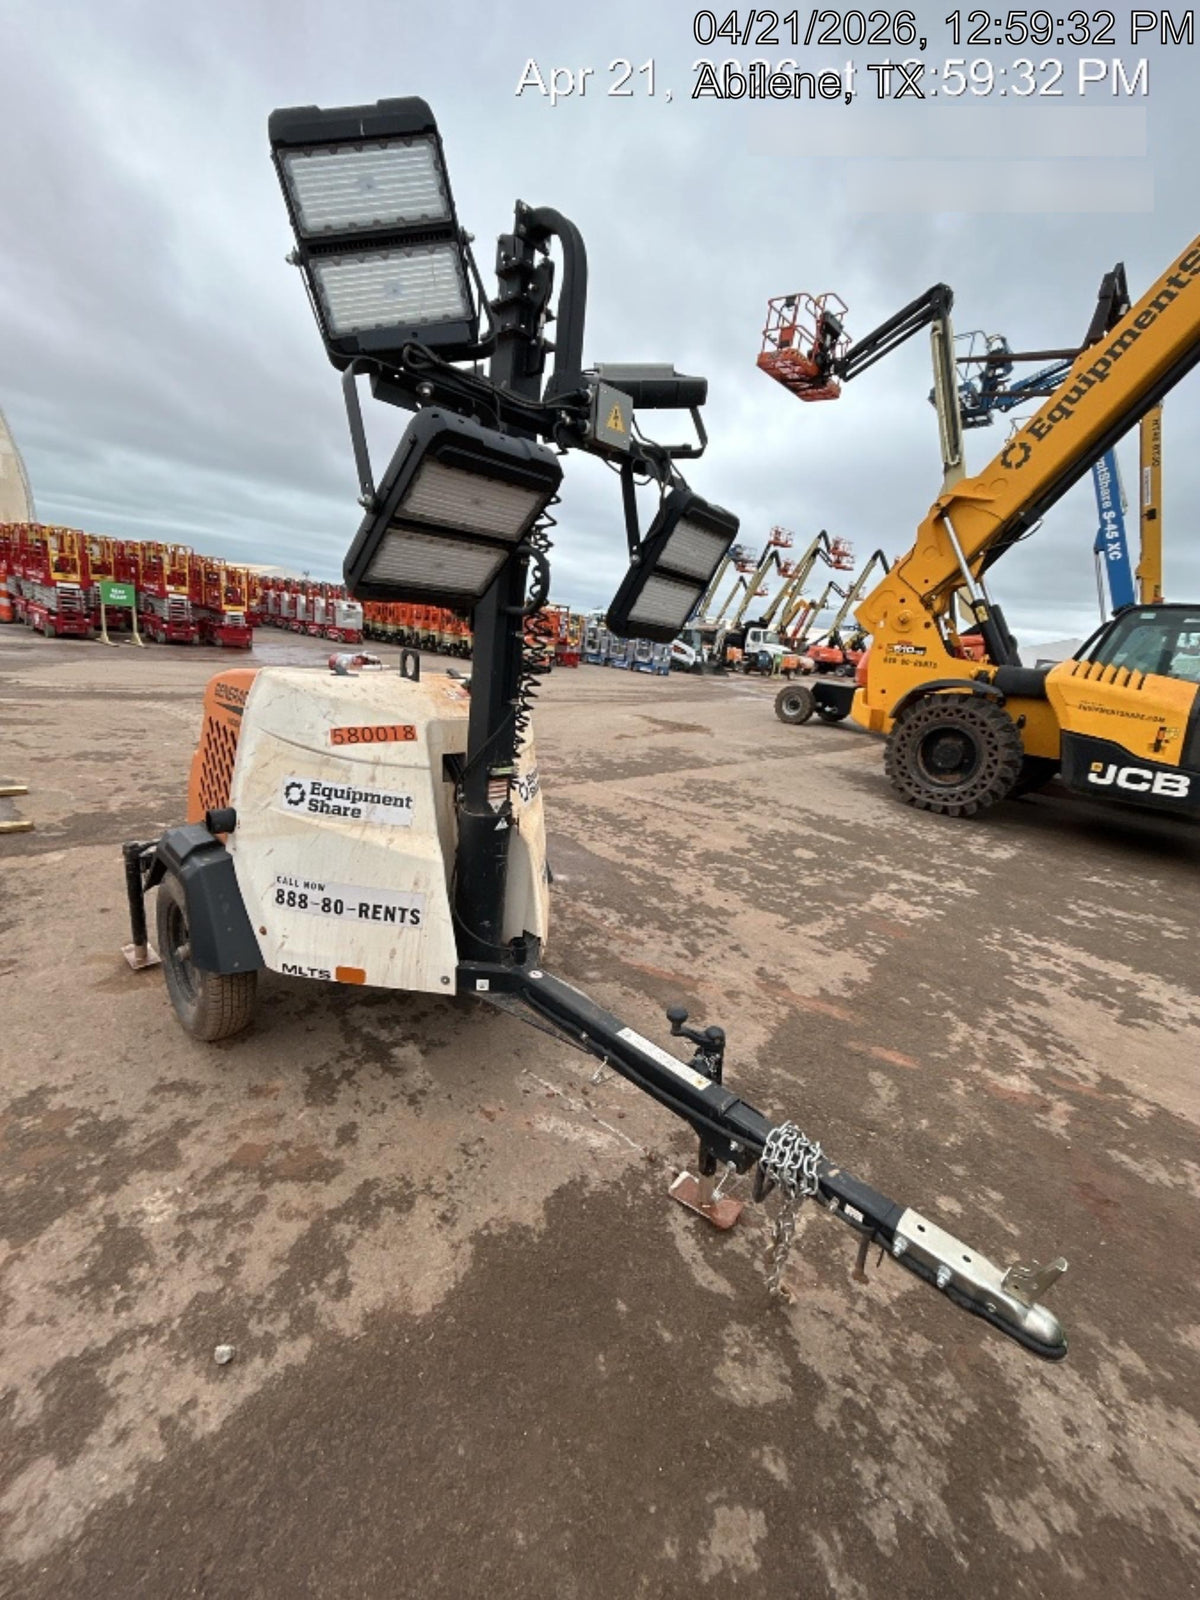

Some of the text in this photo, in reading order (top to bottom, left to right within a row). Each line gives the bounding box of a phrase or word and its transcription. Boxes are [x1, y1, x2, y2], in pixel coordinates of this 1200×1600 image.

[1027, 241, 1200, 441] EquipmentS
[1102, 510, 1119, 541] S-45
[1107, 542, 1122, 561] XC
[332, 725, 417, 743] 580018
[1087, 763, 1191, 797] JCB
[310, 782, 413, 810] Equipment
[308, 799, 362, 819] Share
[276, 876, 326, 892] CALL NOW
[274, 888, 421, 926] 888-80-RENTS
[282, 963, 331, 979] MLTS
